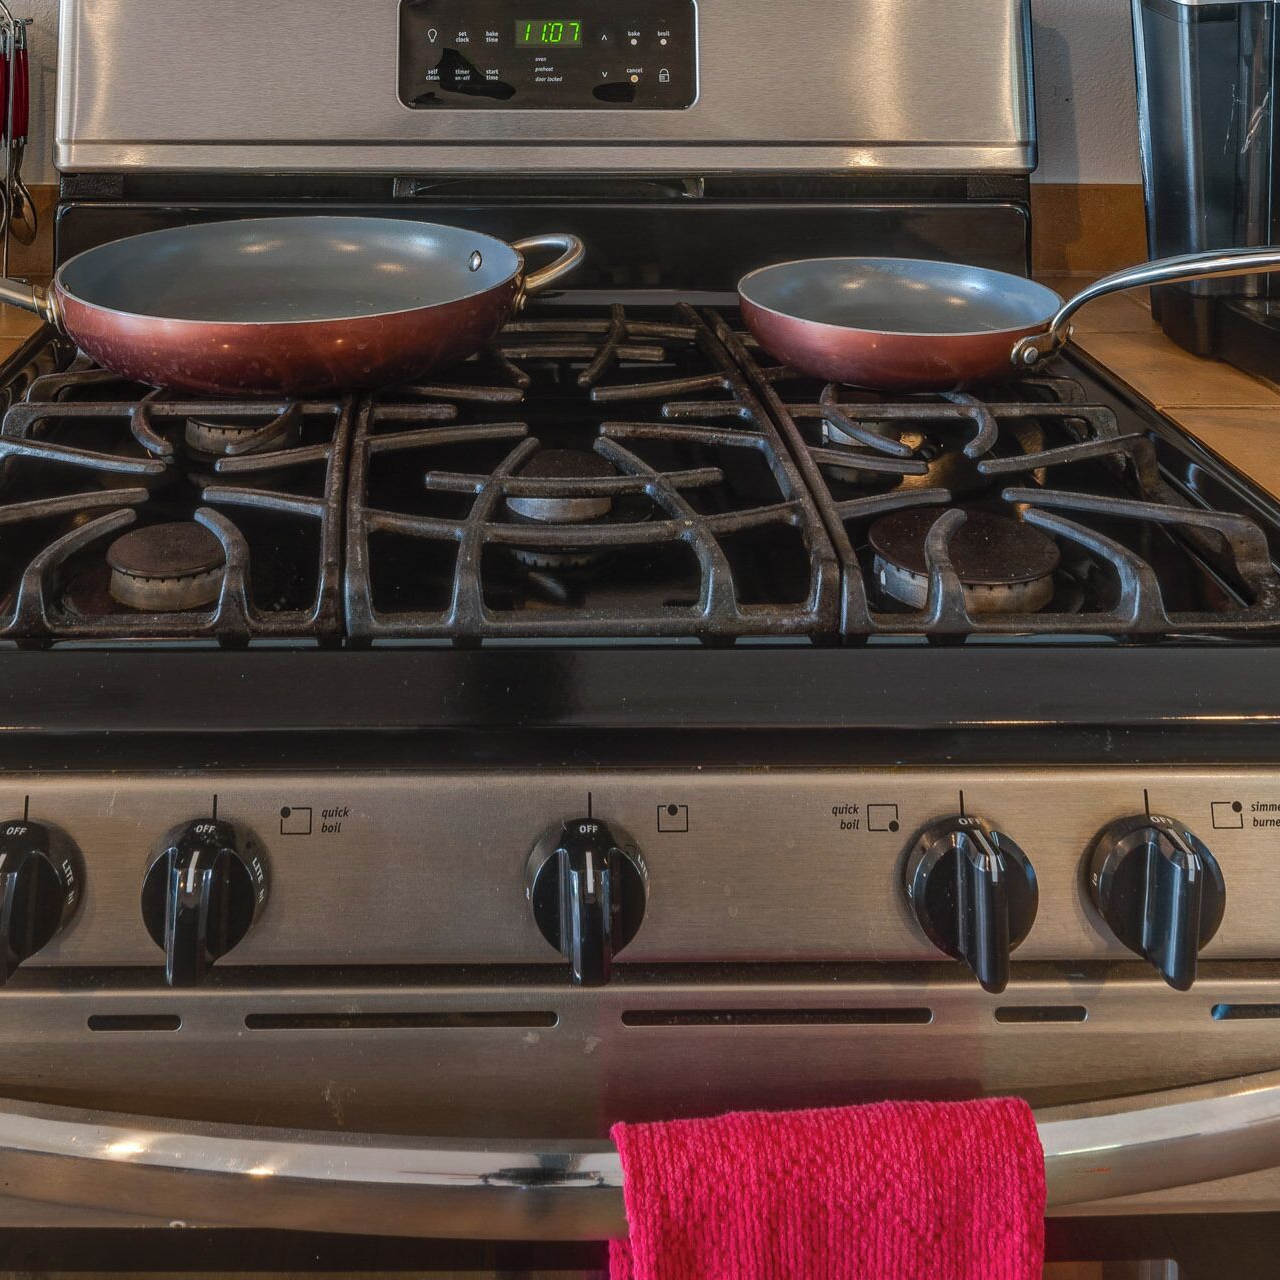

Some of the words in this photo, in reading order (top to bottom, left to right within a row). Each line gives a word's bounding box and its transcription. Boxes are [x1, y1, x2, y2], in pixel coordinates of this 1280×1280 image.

[525, 22, 580, 43] 11:07
[321, 806, 349, 820] quick
[832, 804, 859, 817] quick
[6, 826, 27, 835] OFF
[195, 824, 216, 833] OFF
[321, 822, 341, 834] boil
[579, 825, 598, 833] OFF
[840, 819, 860, 830] boil
[62, 859, 73, 886] LITE
[252, 857, 264, 884] LITE
